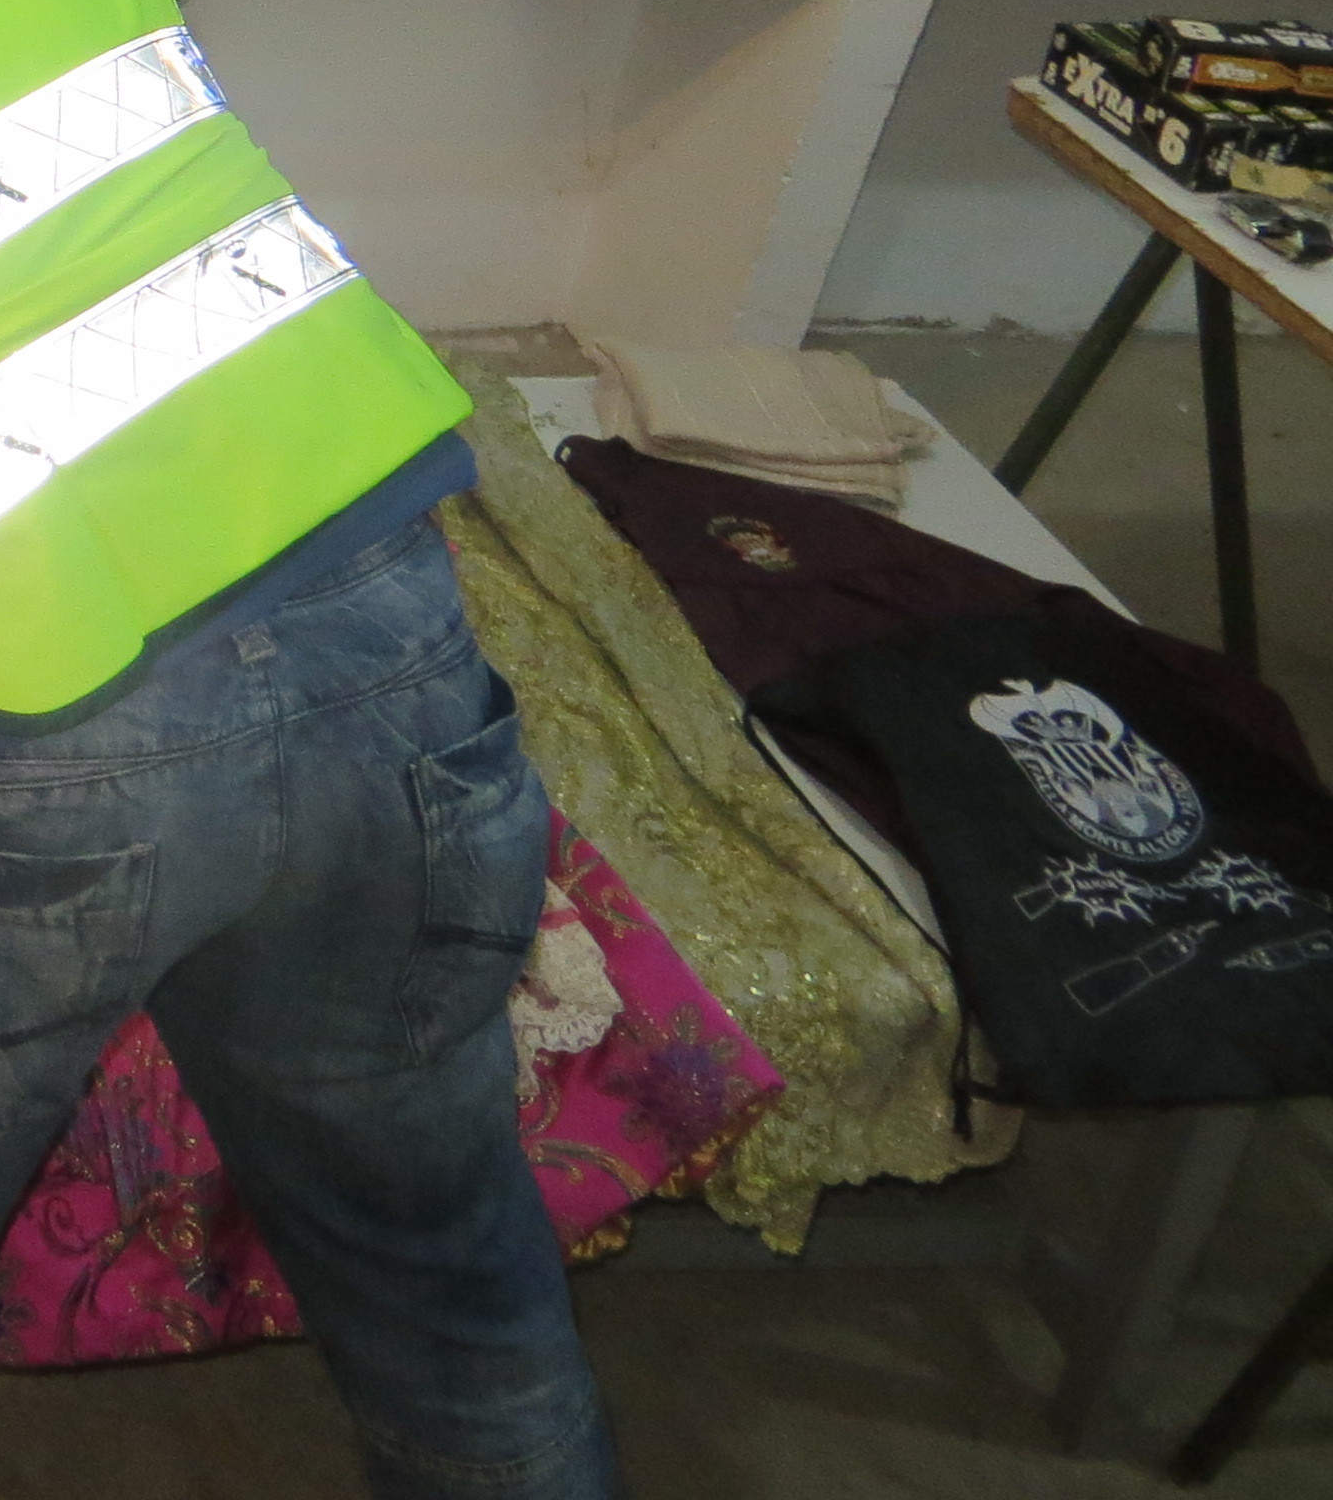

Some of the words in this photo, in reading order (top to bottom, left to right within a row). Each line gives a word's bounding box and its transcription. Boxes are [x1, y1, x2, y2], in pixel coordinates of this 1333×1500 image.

[1062, 51, 1133, 125] EXTRA
[1159, 117, 1191, 166] 6
[1068, 812, 1135, 856] MONTE
